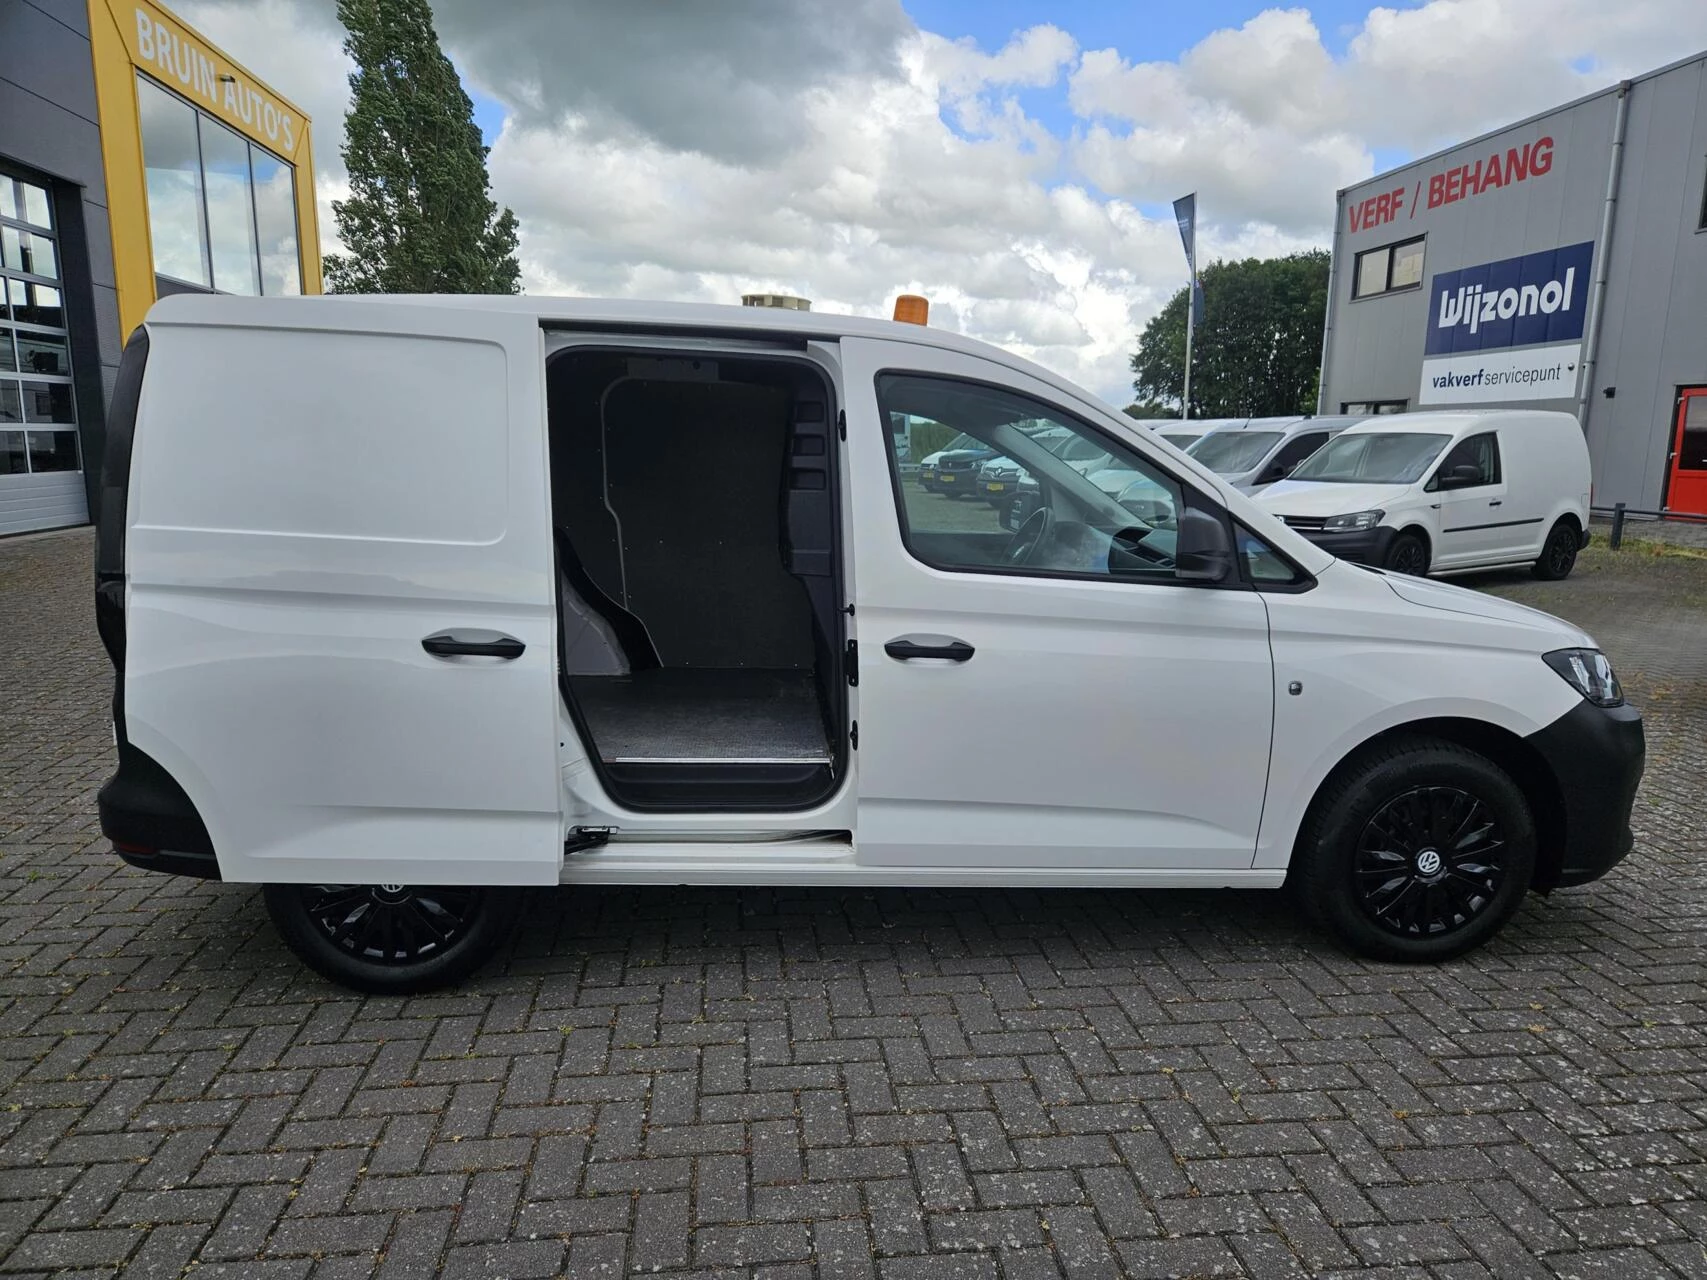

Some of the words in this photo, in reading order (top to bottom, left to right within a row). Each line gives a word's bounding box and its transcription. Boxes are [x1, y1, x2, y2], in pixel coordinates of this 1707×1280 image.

[135, 8, 217, 104] BRUIN
[224, 73, 294, 151] AUTO'S
[1349, 187, 1405, 234] VERF
[1427, 136, 1554, 210] BEHANG
